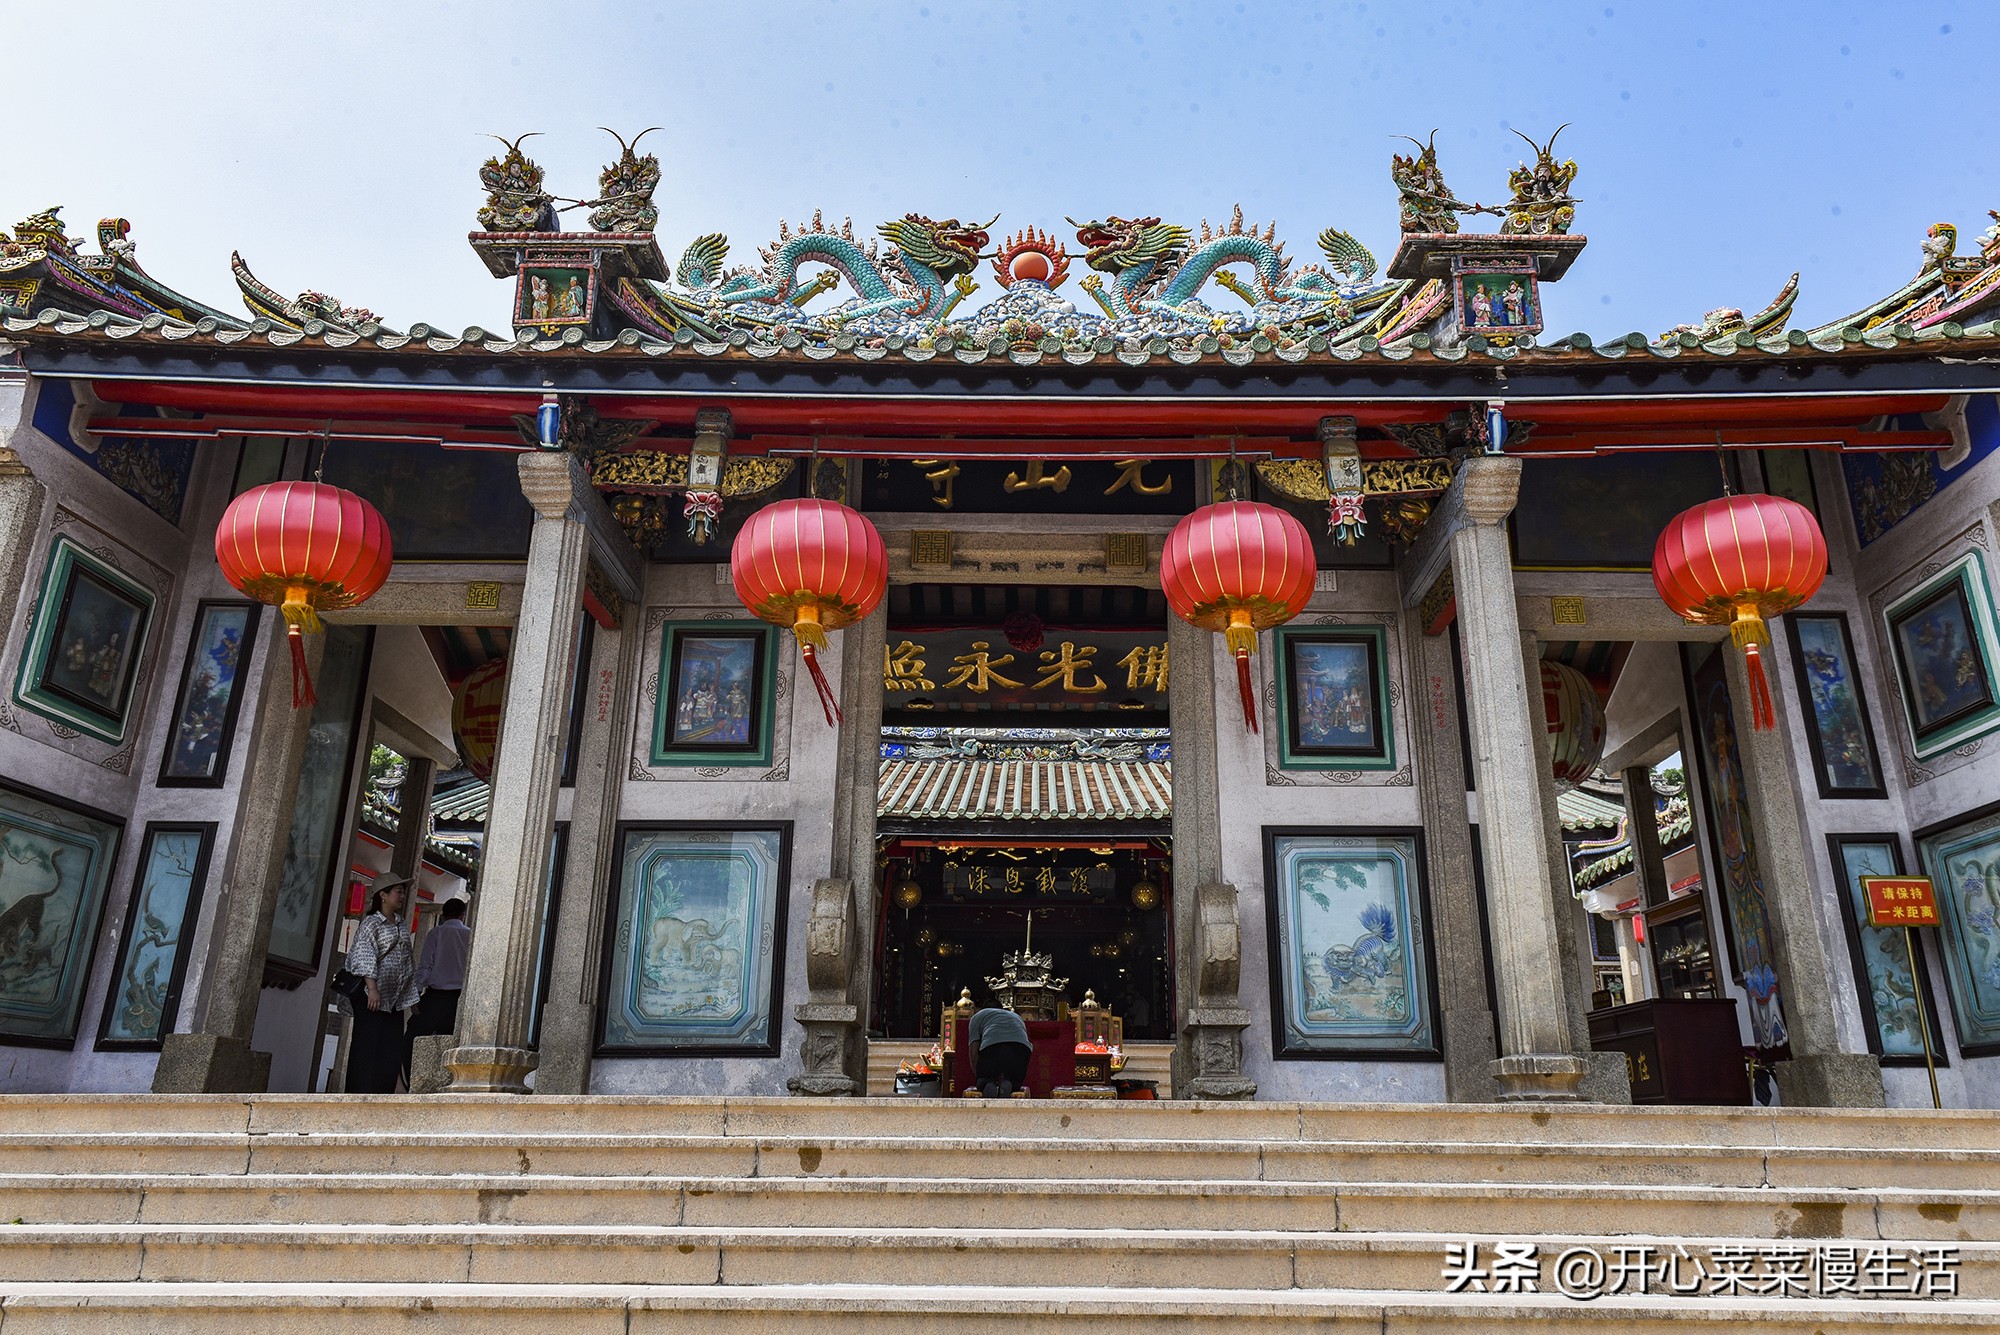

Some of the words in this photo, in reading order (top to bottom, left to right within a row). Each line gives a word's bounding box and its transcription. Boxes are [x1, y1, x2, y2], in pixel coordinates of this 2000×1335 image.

[1882, 887, 1923, 900] 请保持
[1878, 905, 1933, 918] 一米距离
